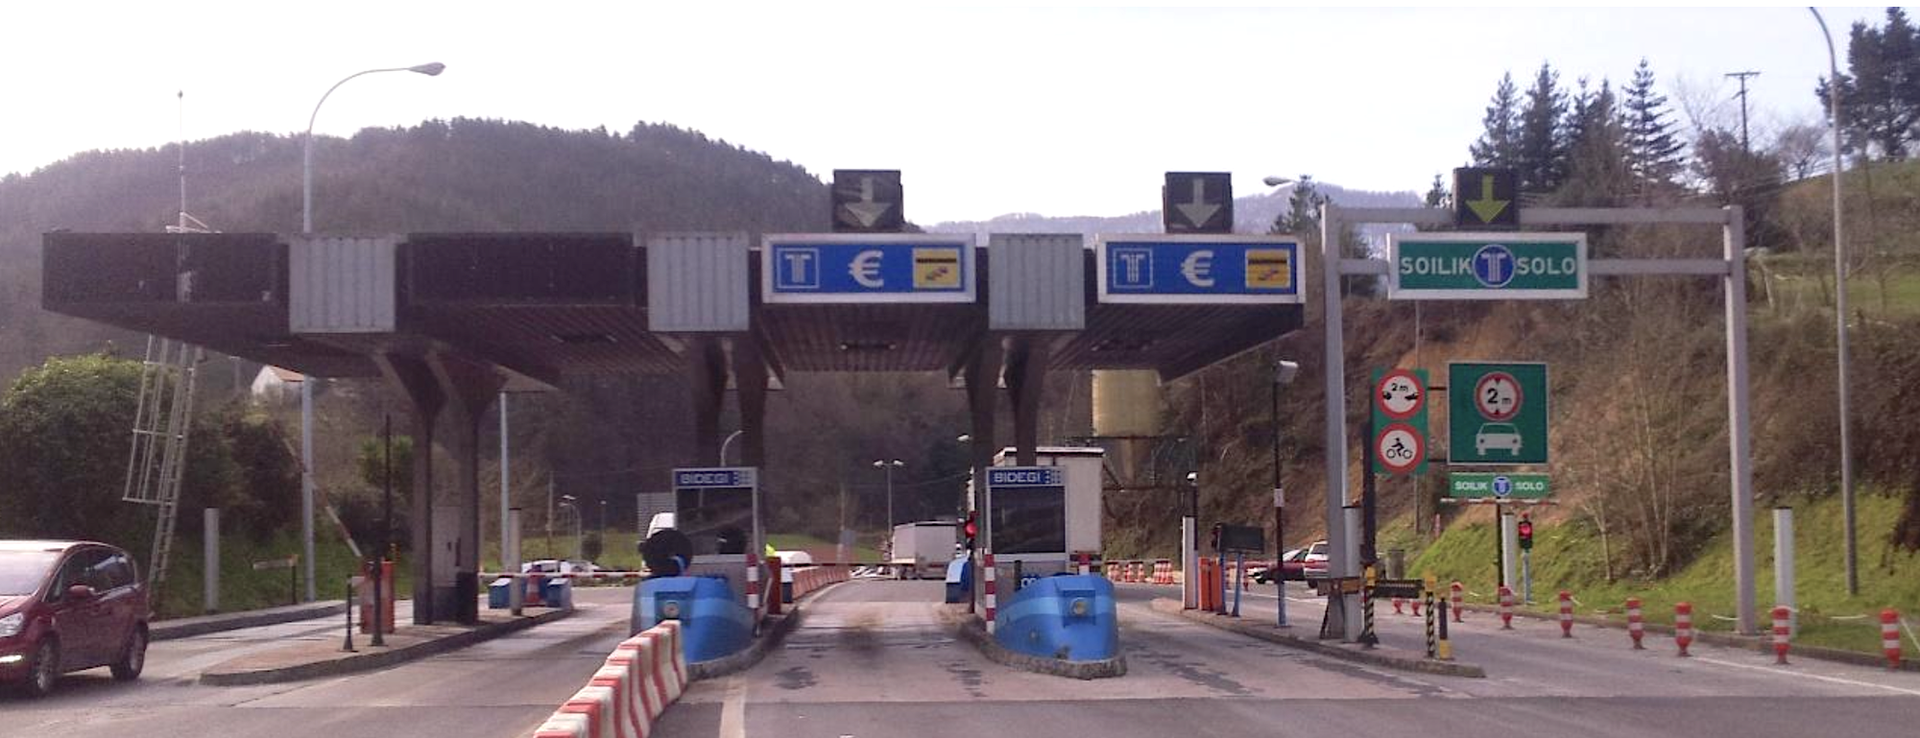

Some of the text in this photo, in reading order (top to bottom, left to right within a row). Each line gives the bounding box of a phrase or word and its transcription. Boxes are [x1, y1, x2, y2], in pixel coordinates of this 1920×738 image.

[1401, 256, 1473, 275] SOILIK
[1517, 256, 1576, 275] SOLO
[1487, 388, 1498, 404] 2
[681, 472, 729, 484] BIDEGI
[995, 471, 1041, 483] BIDEGI
[1454, 481, 1488, 491] SOILIK
[1515, 481, 1544, 491] SOLO
